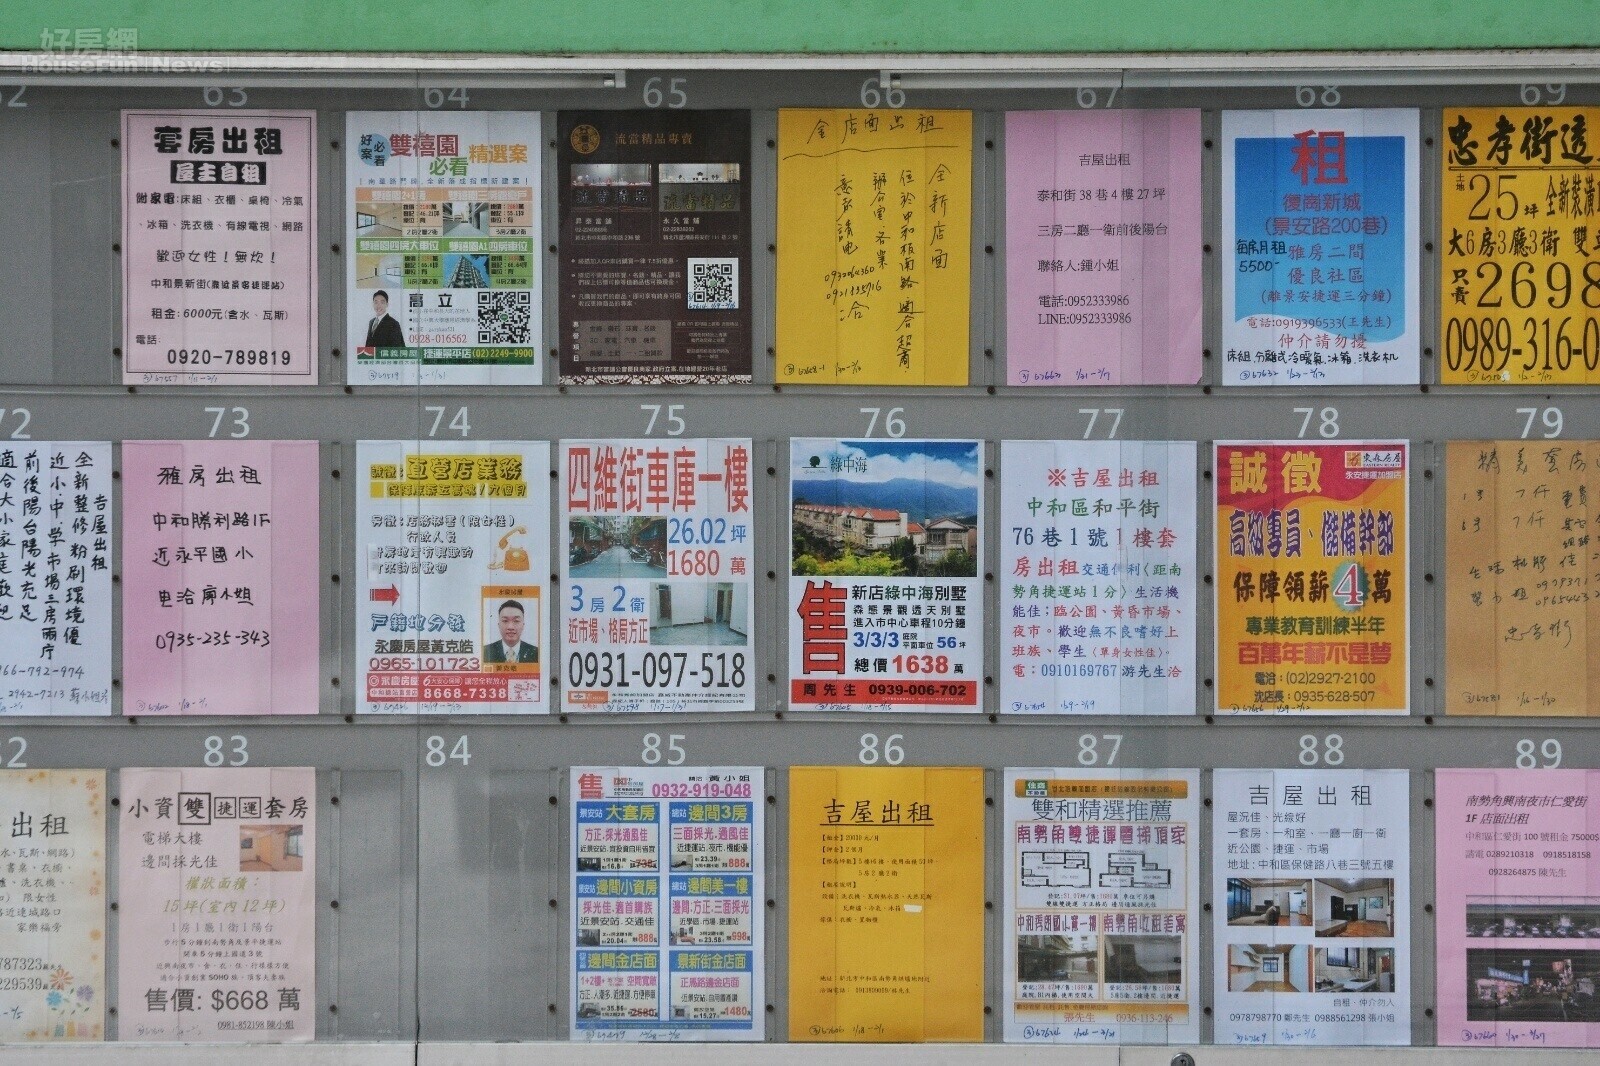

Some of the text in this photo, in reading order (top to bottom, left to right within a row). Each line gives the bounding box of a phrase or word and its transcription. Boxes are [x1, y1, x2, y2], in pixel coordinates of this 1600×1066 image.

[203, 86, 248, 106] 63
[425, 88, 469, 108] 64
[643, 77, 687, 108] 65
[860, 78, 905, 109] 66
[1076, 88, 1122, 108] 67
[1295, 86, 1341, 107] 68
[1520, 84, 1566, 105] 69
[154, 126, 283, 156] 套房出租
[389, 133, 459, 157] 雙禧園
[469, 144, 528, 164] 精選案
[1079, 153, 1130, 166] 吉屋出租
[1291, 129, 1348, 187] 租
[175, 162, 261, 184] 屋主自租
[429, 157, 469, 176] 必看
[1037, 189, 1076, 202] 泰和街
[1080, 189, 1092, 201] 38
[1137, 189, 1149, 200] 27
[1468, 174, 1539, 221] 25 坪
[1038, 223, 1167, 237] 三房二廳一衛前後陽台
[1265, 216, 1388, 236] (景安路200巷)
[1288, 243, 1365, 261] 雅房二間
[1287, 267, 1364, 284] 優良社區
[1476, 261, 1600, 310] 2698
[1038, 295, 1129, 308] 電話:0952333986
[1261, 289, 1392, 303] (離景安捷運三分鐘)
[1038, 313, 1131, 325] LINE:0952333986
[136, 334, 161, 345] 電話:
[409, 334, 467, 344] 0928-016562
[1278, 333, 1367, 350] 仲介請勿擾
[167, 349, 291, 366] 0920-789819
[380, 349, 418, 357] 信義房屋
[472, 349, 533, 358] (02)2249-9900
[204, 406, 250, 438] 73
[425, 406, 471, 437] 74
[640, 405, 685, 436] 75
[860, 407, 906, 438] 76
[1078, 408, 1124, 439] 77
[1293, 407, 1339, 438] 78
[1516, 407, 1564, 438] 79
[407, 458, 523, 480] 直營店業務
[830, 456, 867, 473] 綠中海
[1229, 451, 1322, 494] 誠徵
[157, 465, 261, 486] 雅房出租
[568, 446, 748, 513] 四維街車庫一樓
[1027, 497, 1160, 519] 中和區和平街
[91, 494, 107, 571] 吉屋出租
[407, 531, 456, 543] 行政人員
[668, 518, 746, 544] 26.02 坪
[1229, 508, 1394, 559] 高級專員、儲備幹部
[152, 546, 253, 566] 近永平國小
[668, 549, 746, 576] 1680 萬
[852, 585, 967, 601] 新店綠中海別墅
[568, 618, 648, 645] 近市場、格局方正
[797, 580, 848, 675] 售
[853, 617, 966, 629] 進入市中心車程10分鐘
[1245, 616, 1385, 636] 專業教育訓練半年
[156, 630, 270, 652] 0935-235-343
[853, 631, 900, 648] 3/3/3
[936, 636, 957, 649] 56
[1237, 641, 1392, 665] 百萬年薪不是夢
[369, 658, 480, 670] 0965-101723
[568, 652, 746, 689] 0931-097-518
[854, 654, 964, 674] 總價 1638 萬
[381, 676, 419, 686] 永慶房屋
[803, 683, 966, 696] 周先生 0939-006-702
[424, 688, 507, 698] 8668-7338
[204, 736, 249, 767] 83
[426, 735, 471, 767] 84
[641, 733, 686, 765] 85
[858, 733, 904, 765] 86
[1077, 734, 1123, 765] 87
[1299, 734, 1344, 765] 88
[1516, 738, 1562, 769] 89
[578, 773, 604, 799] 售
[652, 783, 751, 797] 0932-919-048
[1249, 785, 1372, 806] 吉屋出租
[128, 795, 308, 821] 小資雙捷運套房
[824, 798, 933, 823] 吉屋出租
[1032, 799, 1172, 821] 雙和精選推薦
[1465, 795, 1588, 808] 南勢角興南夜市仁愛街
[606, 805, 655, 821] 大套房
[688, 805, 747, 821] 邊間3房
[1228, 811, 1306, 823] 屋況佳、光線好
[1479, 812, 1529, 825] 店面出租
[11, 811, 70, 838] 出租
[142, 831, 202, 845] 電梯大樓
[1228, 843, 1329, 855] 近公園、捷運、市場
[1486, 850, 1534, 858] 0289210318
[1543, 851, 1591, 859] 0918518158
[141, 854, 218, 869] 邊間採光佳
[1488, 868, 1567, 877] 0928264875 陳先生
[597, 879, 657, 896] 邊間小資房
[688, 878, 748, 894] 邊間美一樓
[588, 954, 657, 969] 邊間金店面
[678, 954, 746, 969] 景新街金店面
[144, 987, 301, 1013] 售價: $668 萬
[217, 1020, 264, 1030] 0981-852198
[1064, 1013, 1173, 1022] 張先生 0936-113-246
[1230, 1013, 1395, 1022] 0978798770 鄭先生 0988561298 張小姐
